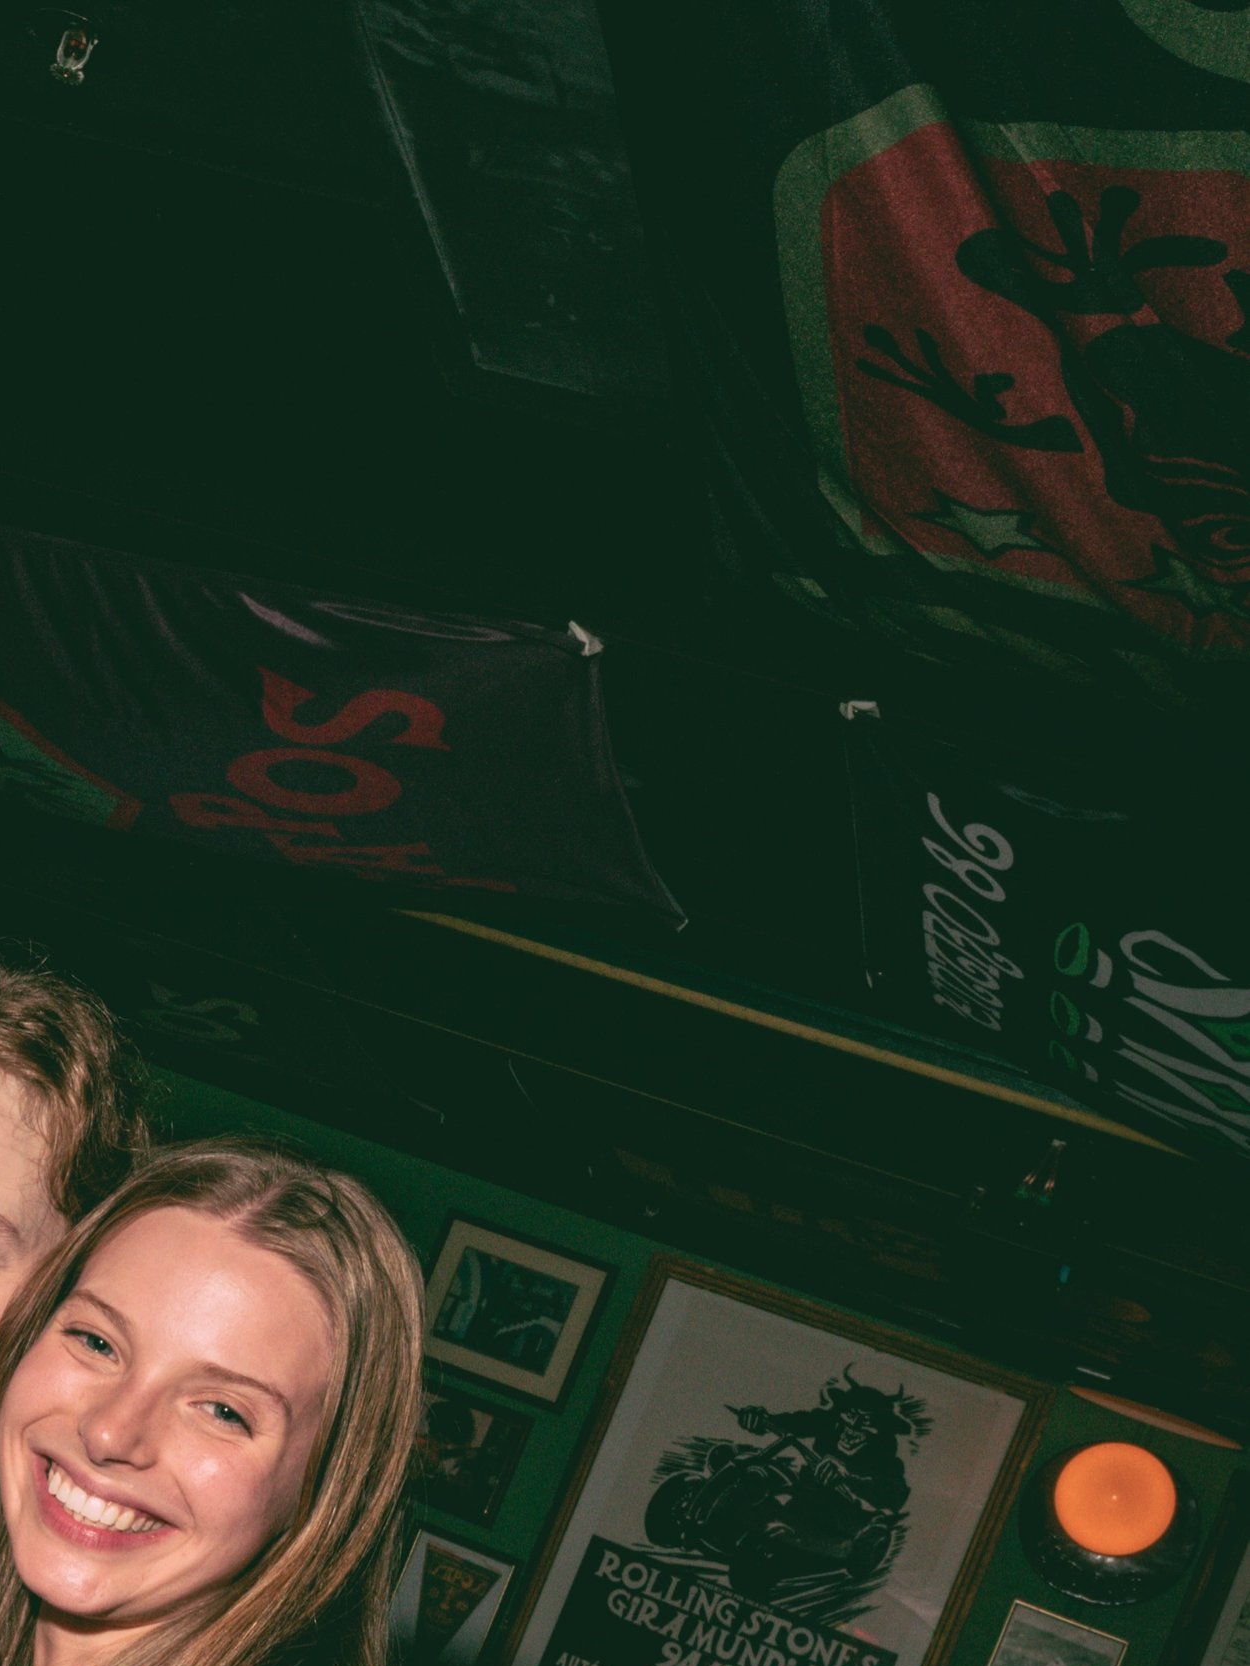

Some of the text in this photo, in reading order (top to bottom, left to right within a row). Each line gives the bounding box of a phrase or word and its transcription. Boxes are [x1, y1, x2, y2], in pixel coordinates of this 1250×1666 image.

[921, 792, 1014, 902] 86
[595, 1550, 739, 1627] ROLLING
[608, 1589, 688, 1640] GIRA
